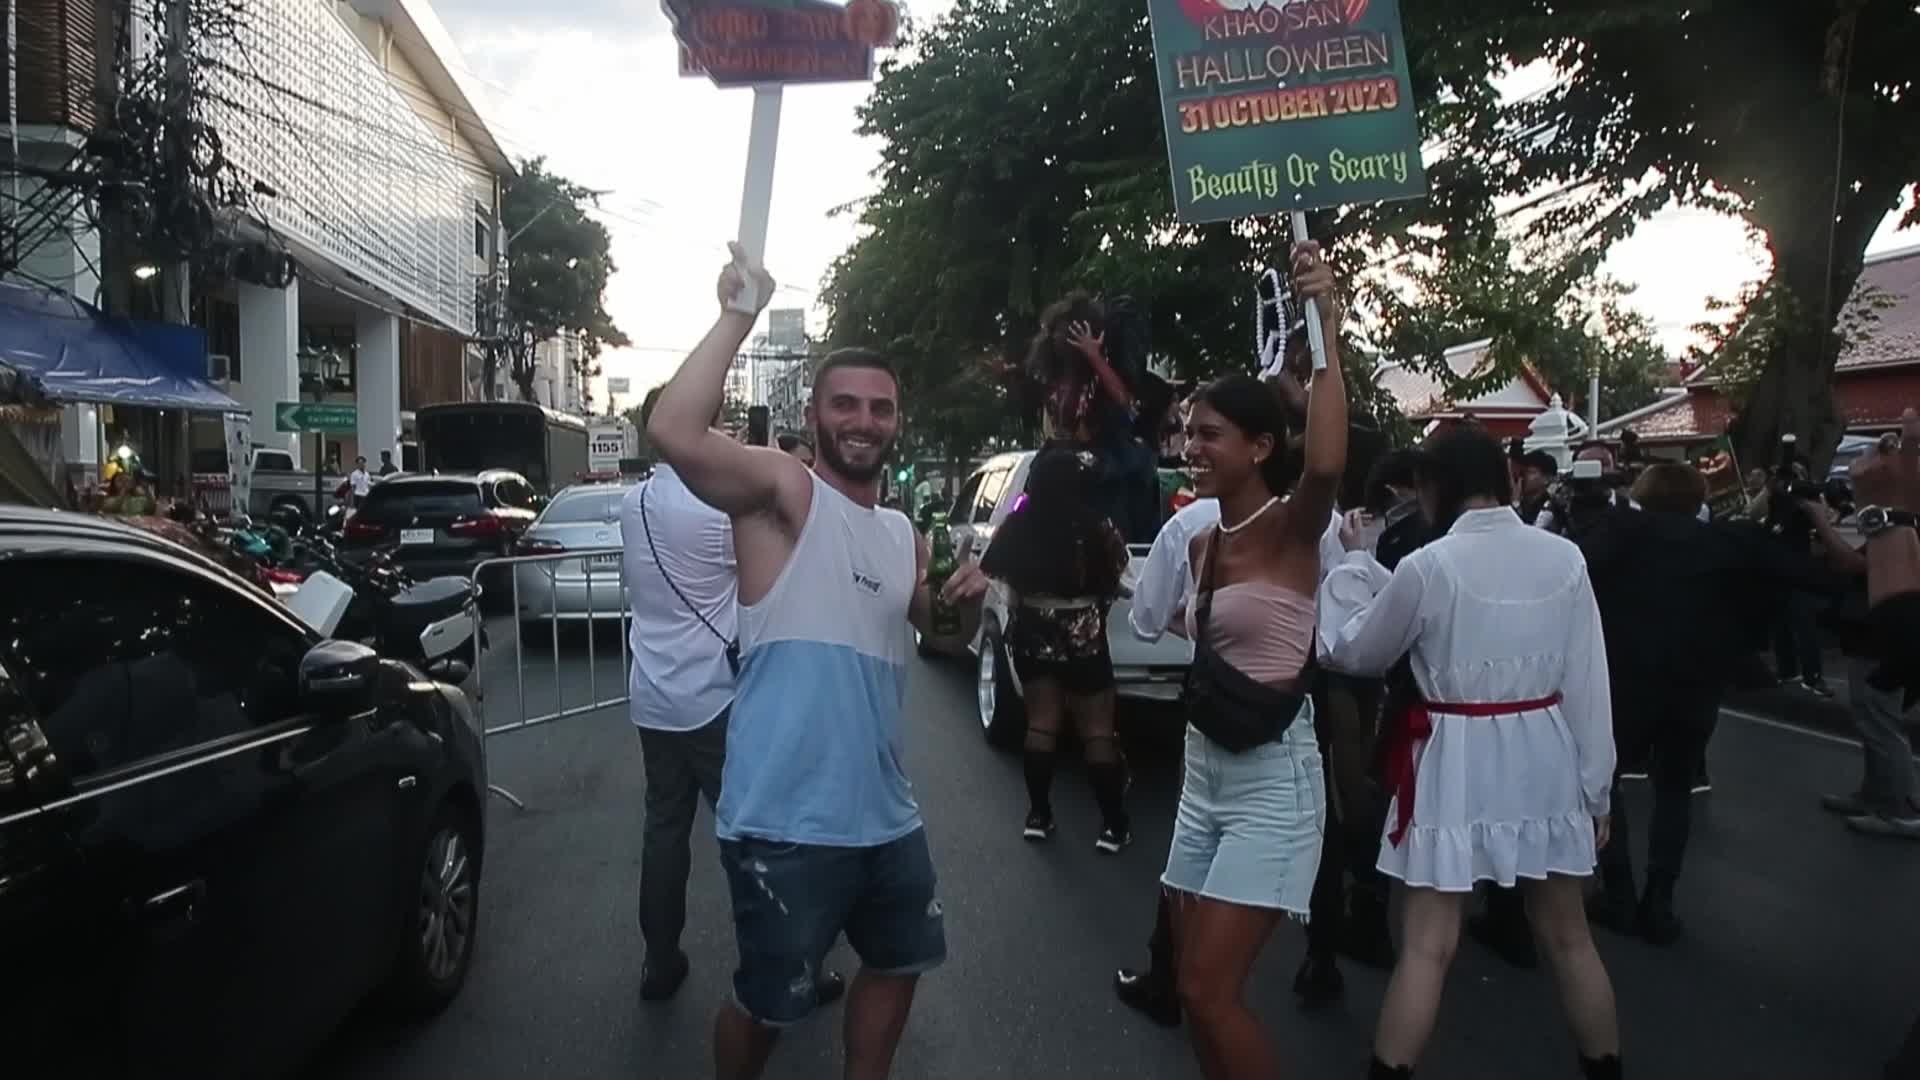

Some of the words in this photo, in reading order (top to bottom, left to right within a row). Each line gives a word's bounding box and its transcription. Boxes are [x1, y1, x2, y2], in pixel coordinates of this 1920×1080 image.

[1205, 10, 1280, 40] KHAO
[1287, 3, 1341, 31] SAN
[1176, 33, 1389, 89] HALLOWEEN
[1179, 100, 1210, 133] 31
[1214, 87, 1328, 128] OCTOBER
[1329, 80, 1398, 115] 2023
[1187, 161, 1278, 204] Beauty
[1286, 153, 1320, 188] Or
[1329, 148, 1408, 183] Scary
[592, 442, 618, 453] 1155
